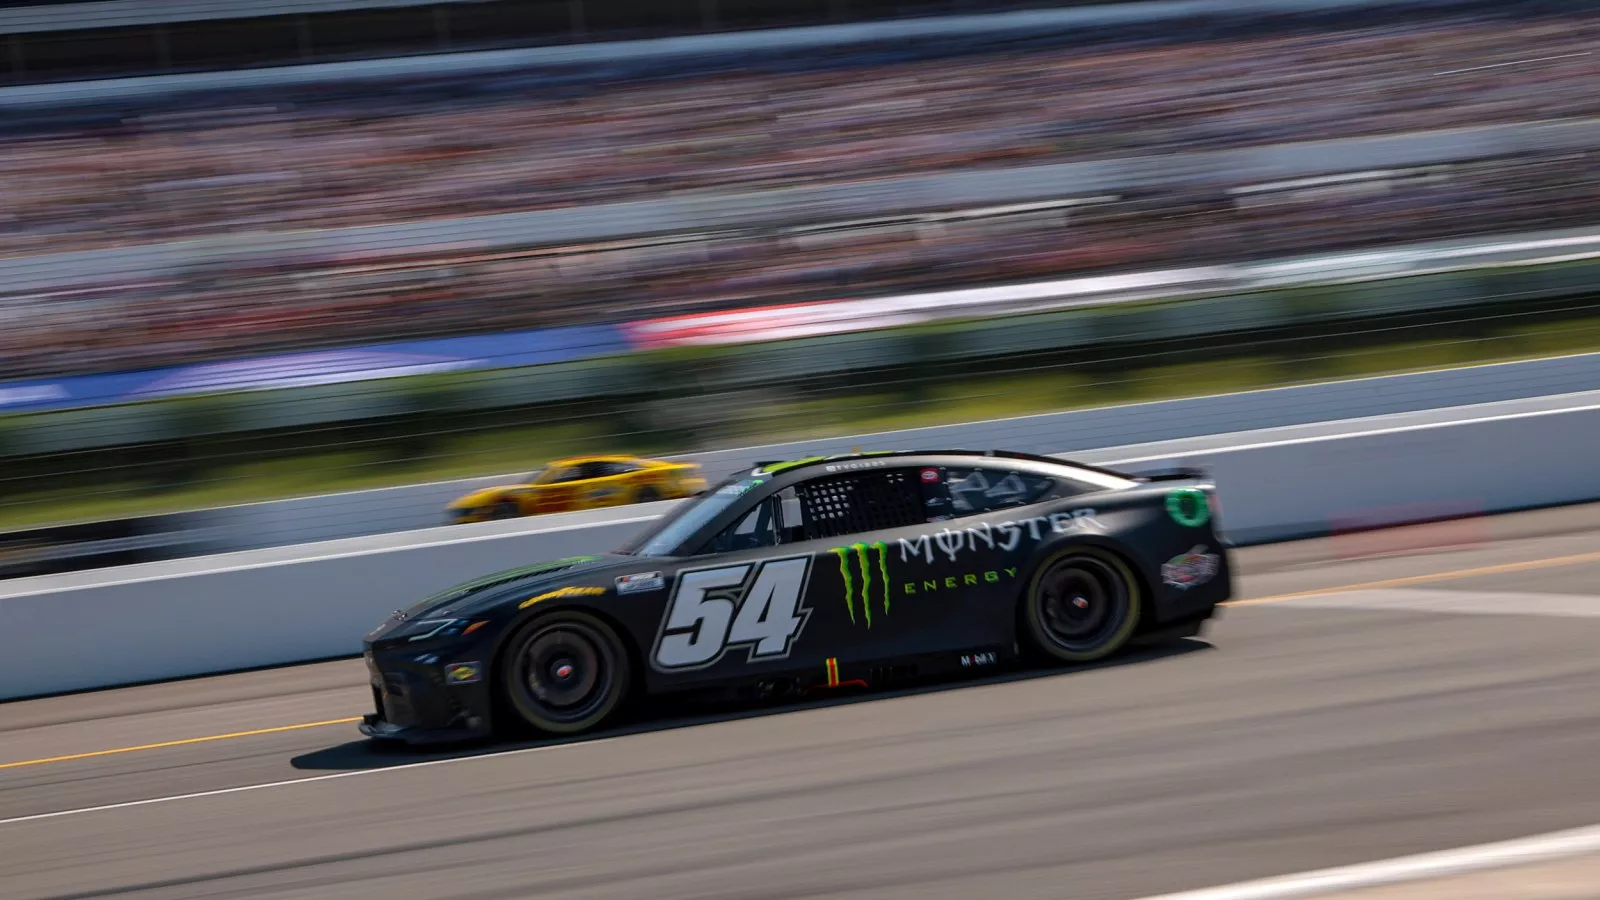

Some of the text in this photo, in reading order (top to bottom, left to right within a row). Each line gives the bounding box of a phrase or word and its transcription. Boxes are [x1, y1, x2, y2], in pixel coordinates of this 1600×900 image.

[899, 508, 1109, 565] MONSTER
[904, 567, 1017, 595] ENERGY
[652, 553, 815, 671] 54
